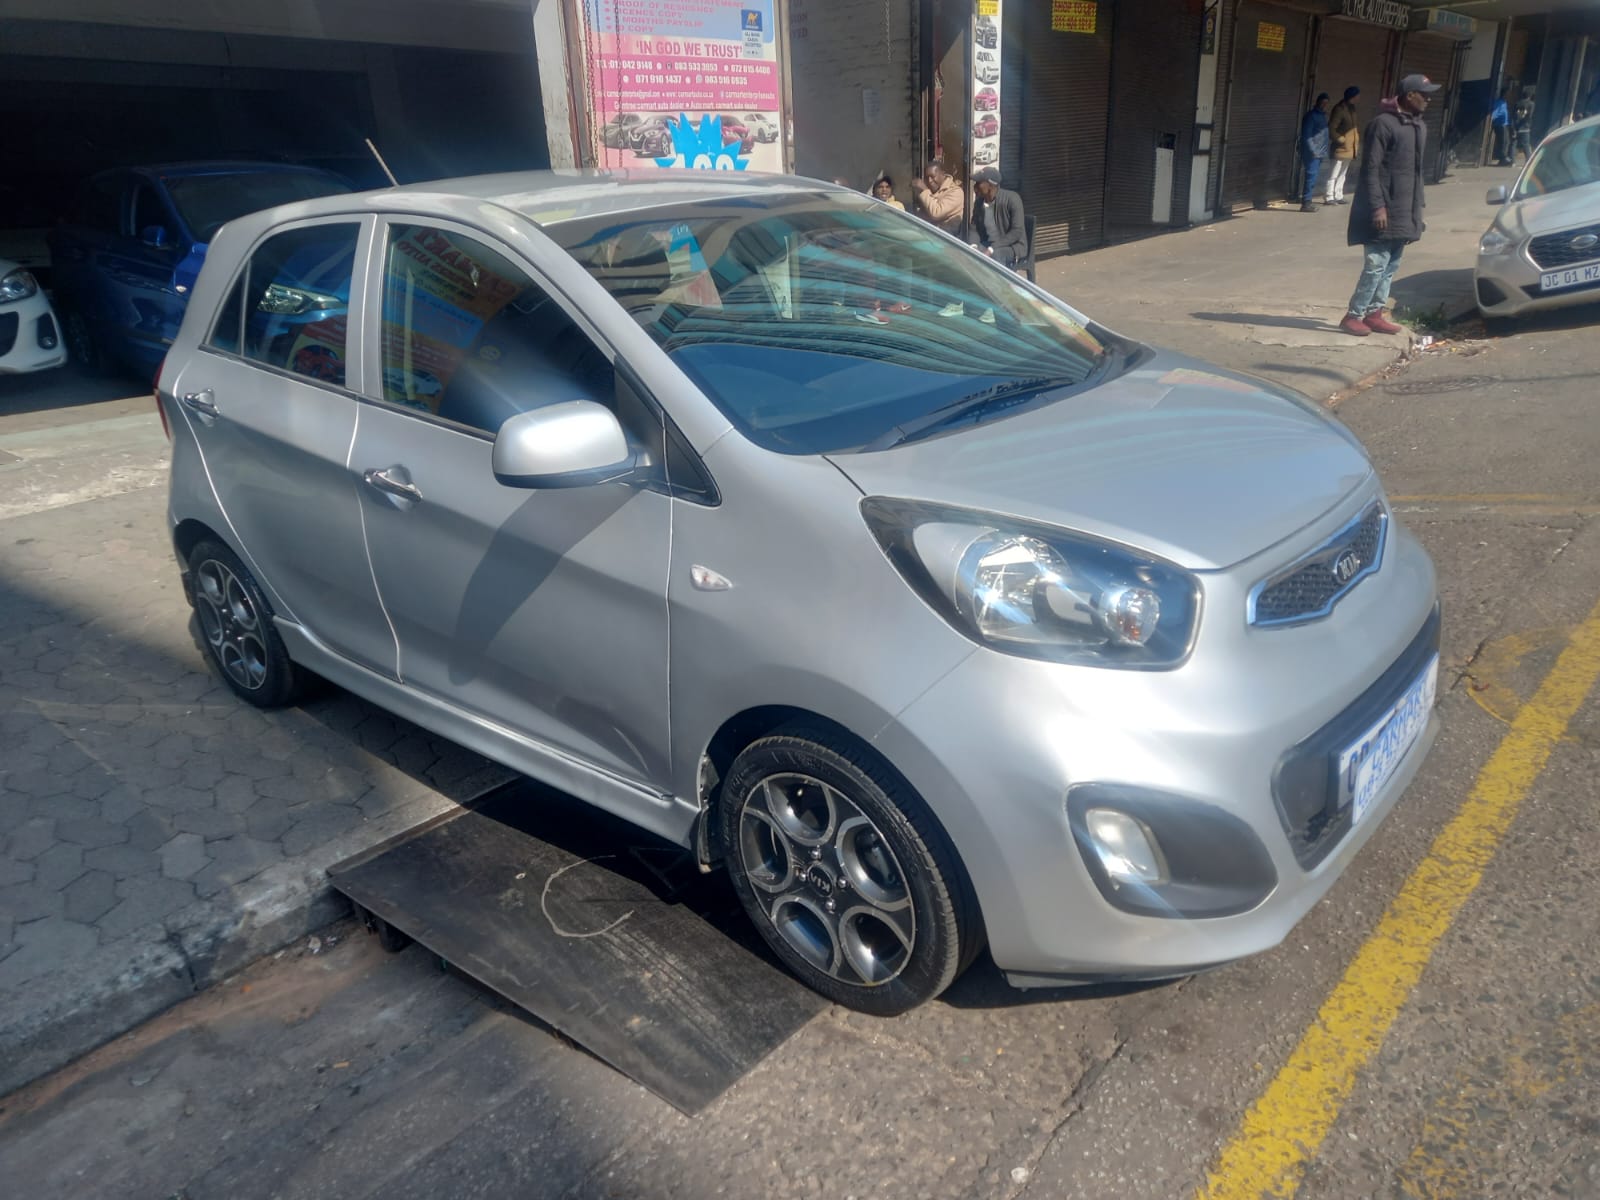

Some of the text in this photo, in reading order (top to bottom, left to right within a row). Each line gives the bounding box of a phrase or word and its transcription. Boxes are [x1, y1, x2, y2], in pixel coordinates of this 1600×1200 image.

[656, 41, 681, 55] GOD
[683, 42, 702, 56] WE
[1545, 274, 1559, 288] JC
[1339, 552, 1360, 580] KIA
[810, 871, 830, 893] KIA
